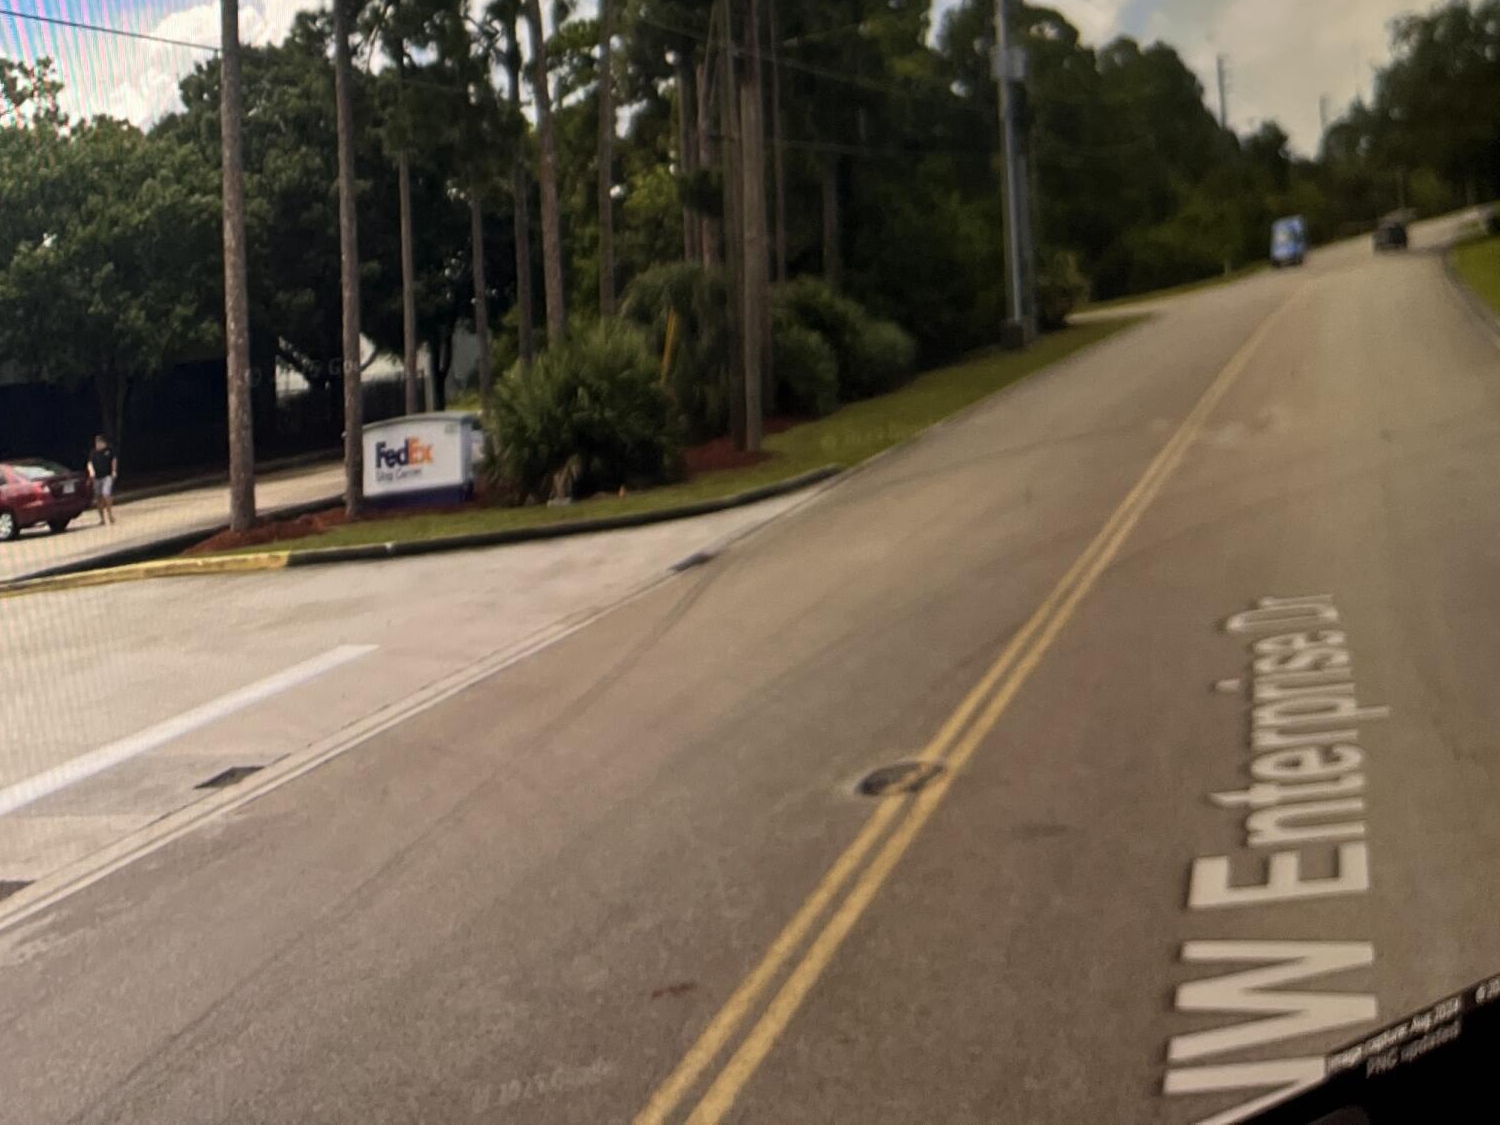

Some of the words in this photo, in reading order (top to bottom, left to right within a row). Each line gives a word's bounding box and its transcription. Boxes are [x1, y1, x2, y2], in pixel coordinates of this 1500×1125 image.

[375, 436, 435, 468] FedEx
[1225, 593, 1339, 632] Dr
[1190, 629, 1390, 907] Enterprise
